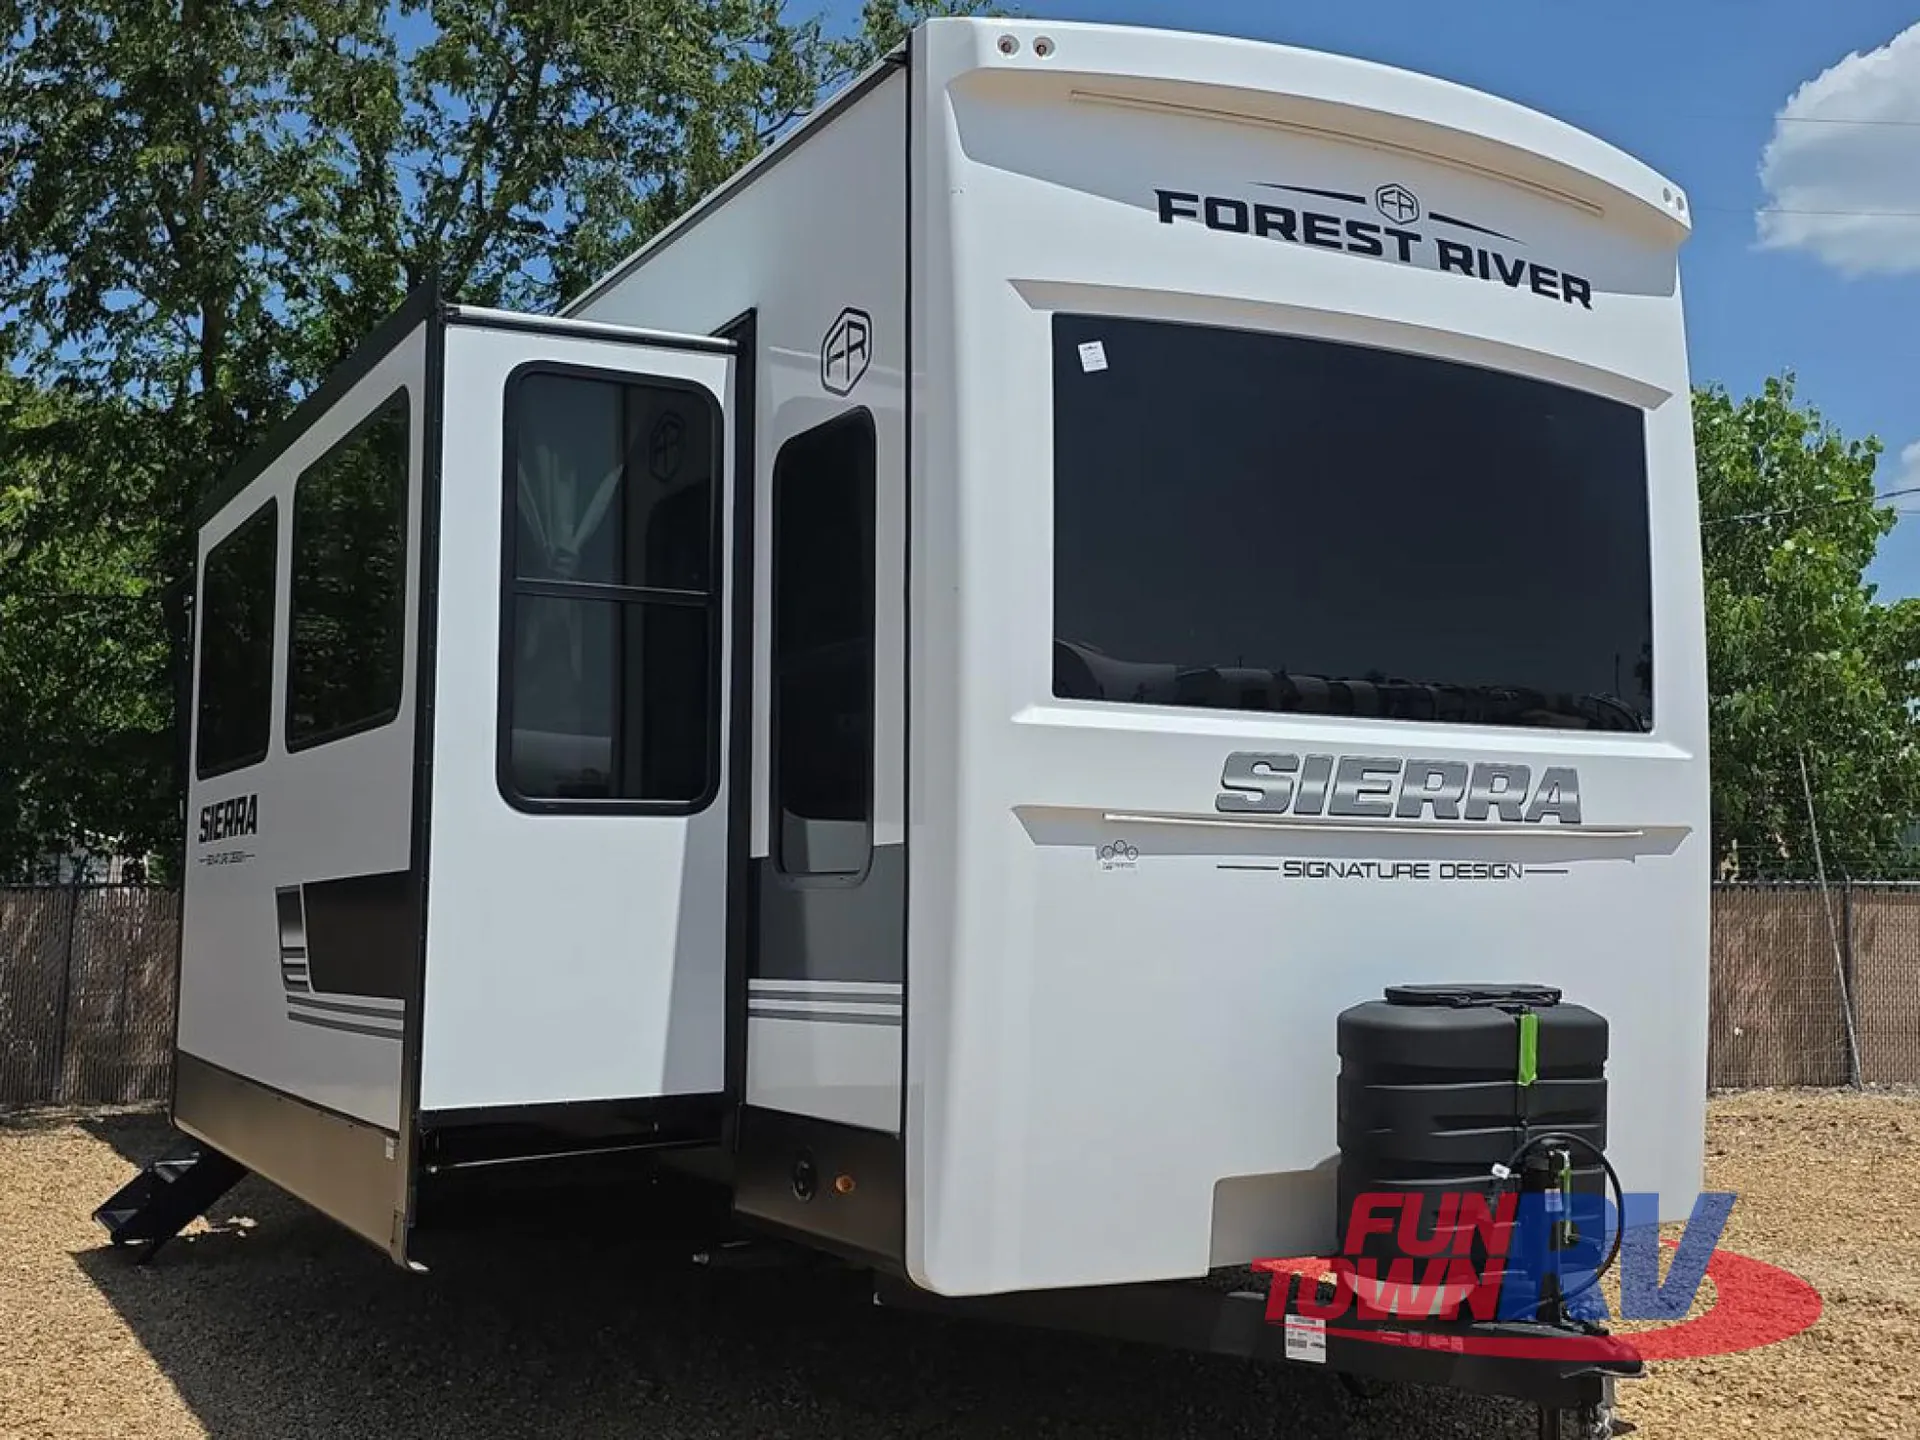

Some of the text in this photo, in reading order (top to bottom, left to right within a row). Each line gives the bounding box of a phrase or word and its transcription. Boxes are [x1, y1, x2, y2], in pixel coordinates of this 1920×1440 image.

[1154, 188, 1592, 310] FOREST RIVER
[1214, 751, 1582, 824] SIERRA
[199, 794, 258, 843] SIERRA
[1282, 860, 1524, 881] SIGNATURE DESIGN
